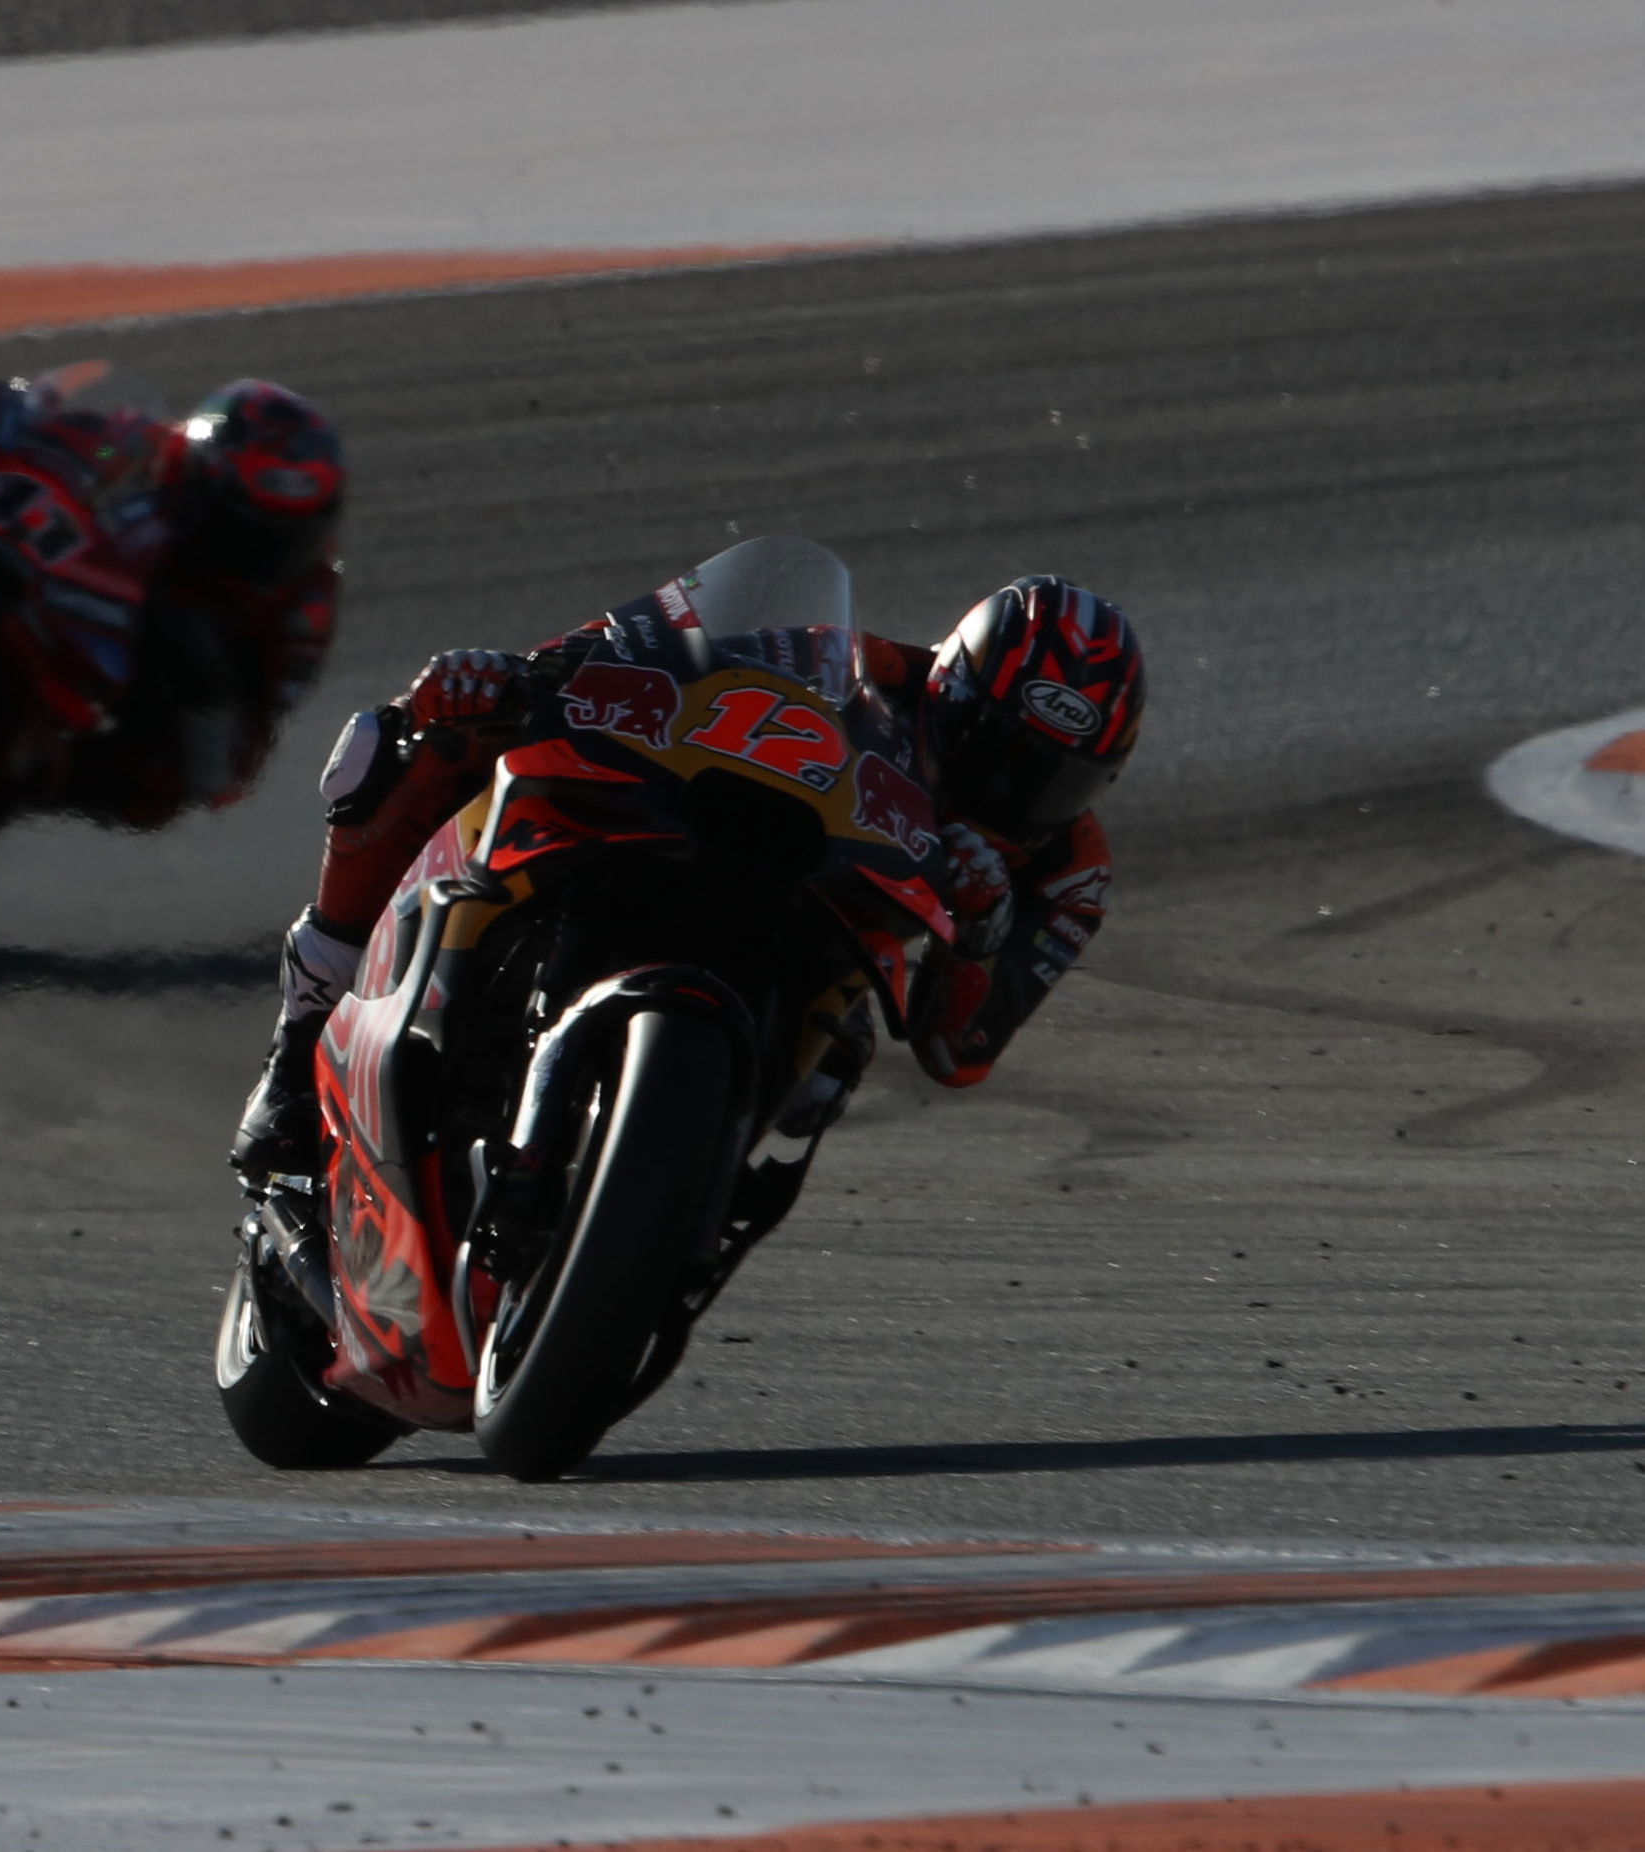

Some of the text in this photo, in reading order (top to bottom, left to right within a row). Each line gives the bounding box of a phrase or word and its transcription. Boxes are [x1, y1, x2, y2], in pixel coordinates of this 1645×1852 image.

[655, 580, 691, 621] MOTUL
[1029, 688, 1091, 726] Arai
[683, 687, 849, 783] 12
